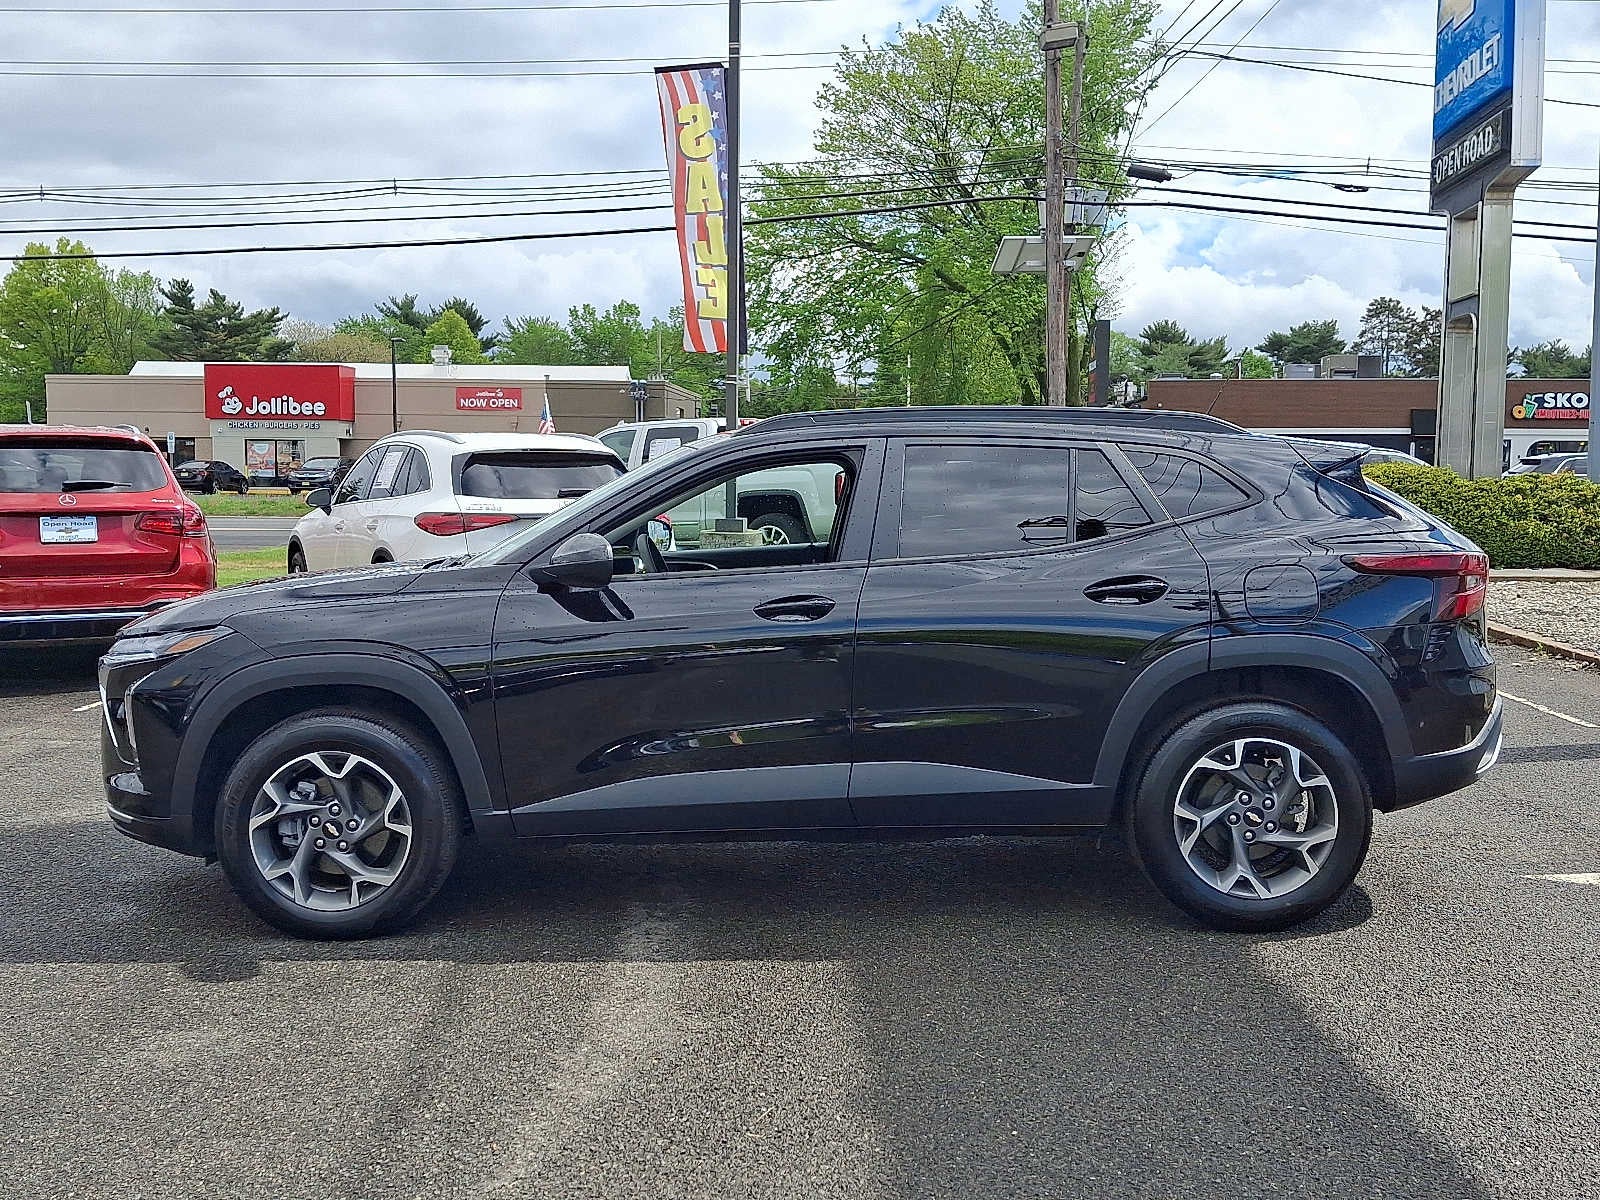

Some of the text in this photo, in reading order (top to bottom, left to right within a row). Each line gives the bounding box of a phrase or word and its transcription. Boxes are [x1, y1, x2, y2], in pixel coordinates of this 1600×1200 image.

[1434, 32, 1502, 115] CHEVROLET
[1435, 126, 1493, 185] OPEN ROAD
[245, 395, 326, 415] Jollibee
[460, 398, 518, 408] NOW OPEN
[1543, 392, 1589, 409] SKO
[227, 421, 259, 429] CHICKEN
[303, 422, 320, 430] PIES
